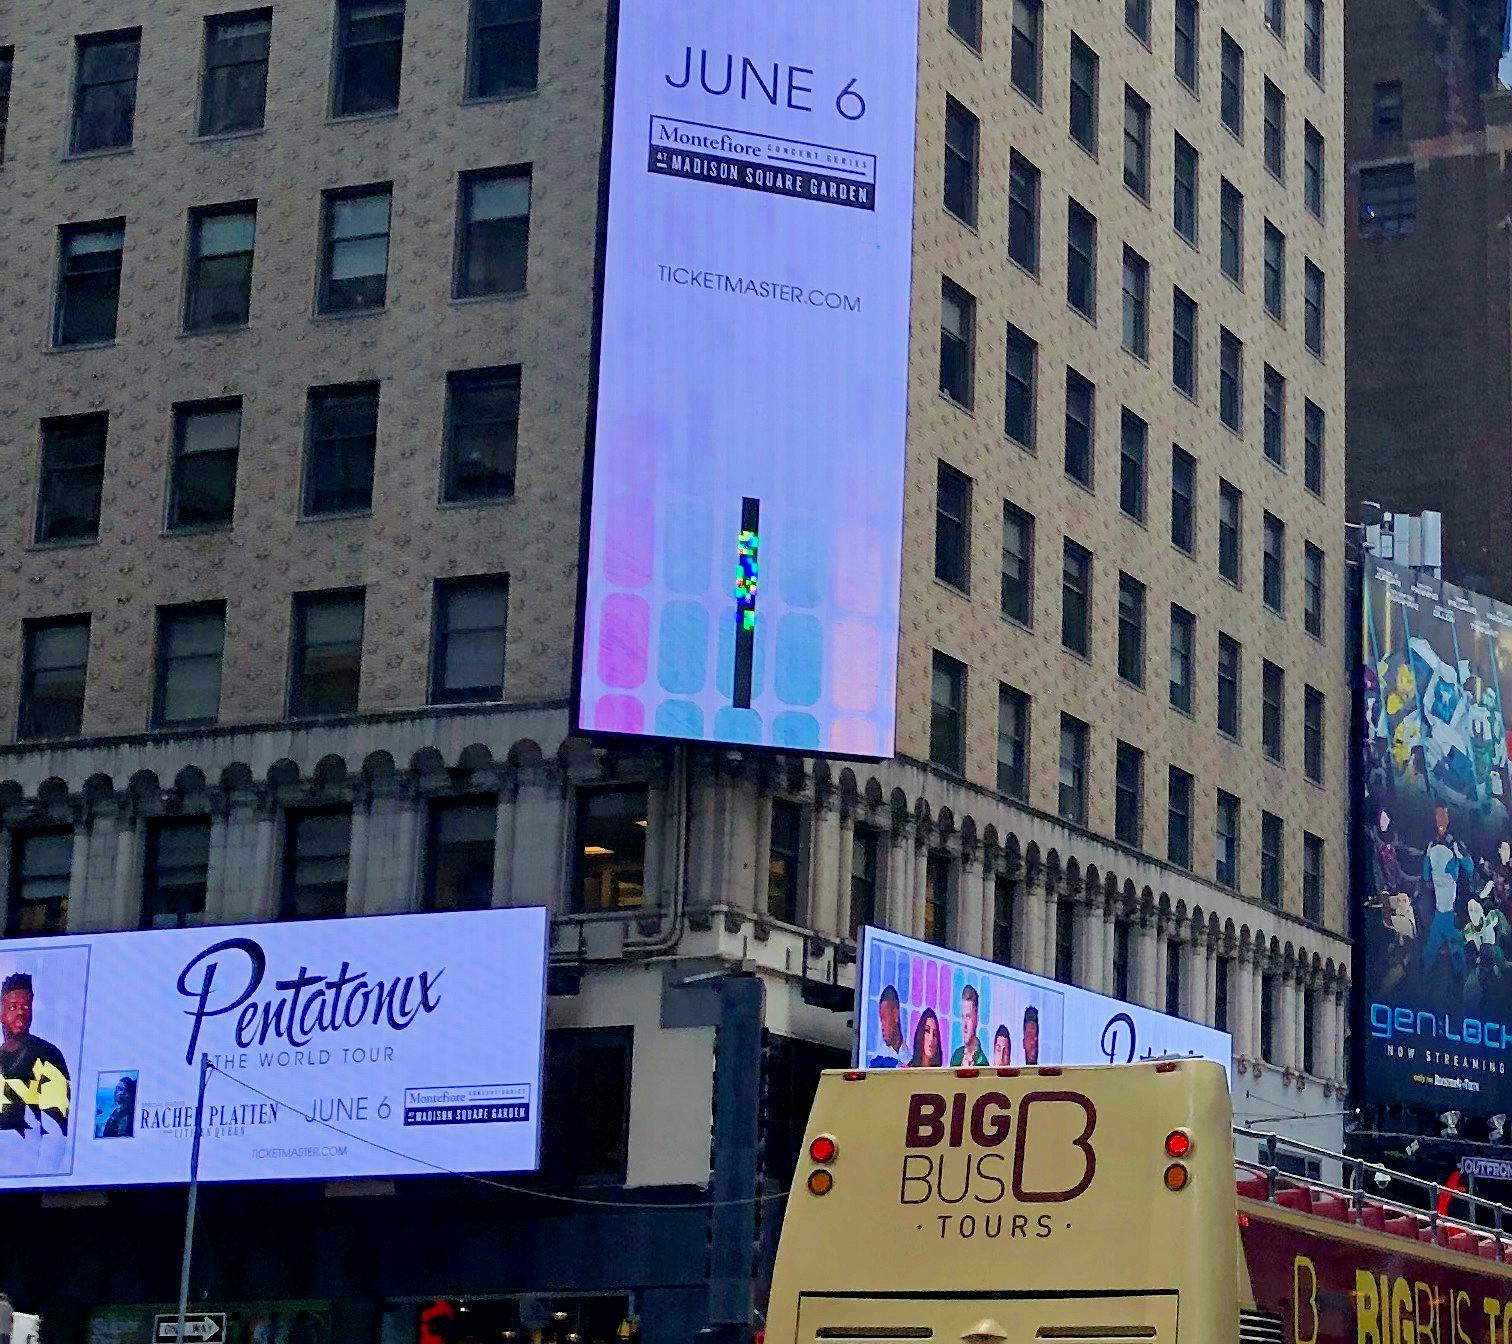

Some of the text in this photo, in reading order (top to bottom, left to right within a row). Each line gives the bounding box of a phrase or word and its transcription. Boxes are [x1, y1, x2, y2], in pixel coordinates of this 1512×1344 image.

[665, 46, 867, 121] JUNE 6
[659, 124, 762, 158] Montefiore
[671, 154, 739, 182] MADISON
[745, 165, 804, 192] SQUARE
[809, 180, 868, 204] GARDEN
[658, 263, 862, 312] TICKETMASTER.COM
[177, 937, 446, 1065] Pentatonix
[213, 1045, 395, 1069] THE WORLD TOUR
[1387, 1044, 1505, 1074] NOW STREAMING
[305, 1096, 393, 1123] JUNE 6
[409, 1090, 467, 1104] Montefiore
[140, 1102, 279, 1130] RACHE PLATTEN
[455, 1108, 489, 1121] SQUARE
[905, 1091, 1012, 1148] BIG
[900, 1153, 1006, 1205] BUS
[937, 1214, 1053, 1238] TOURS
